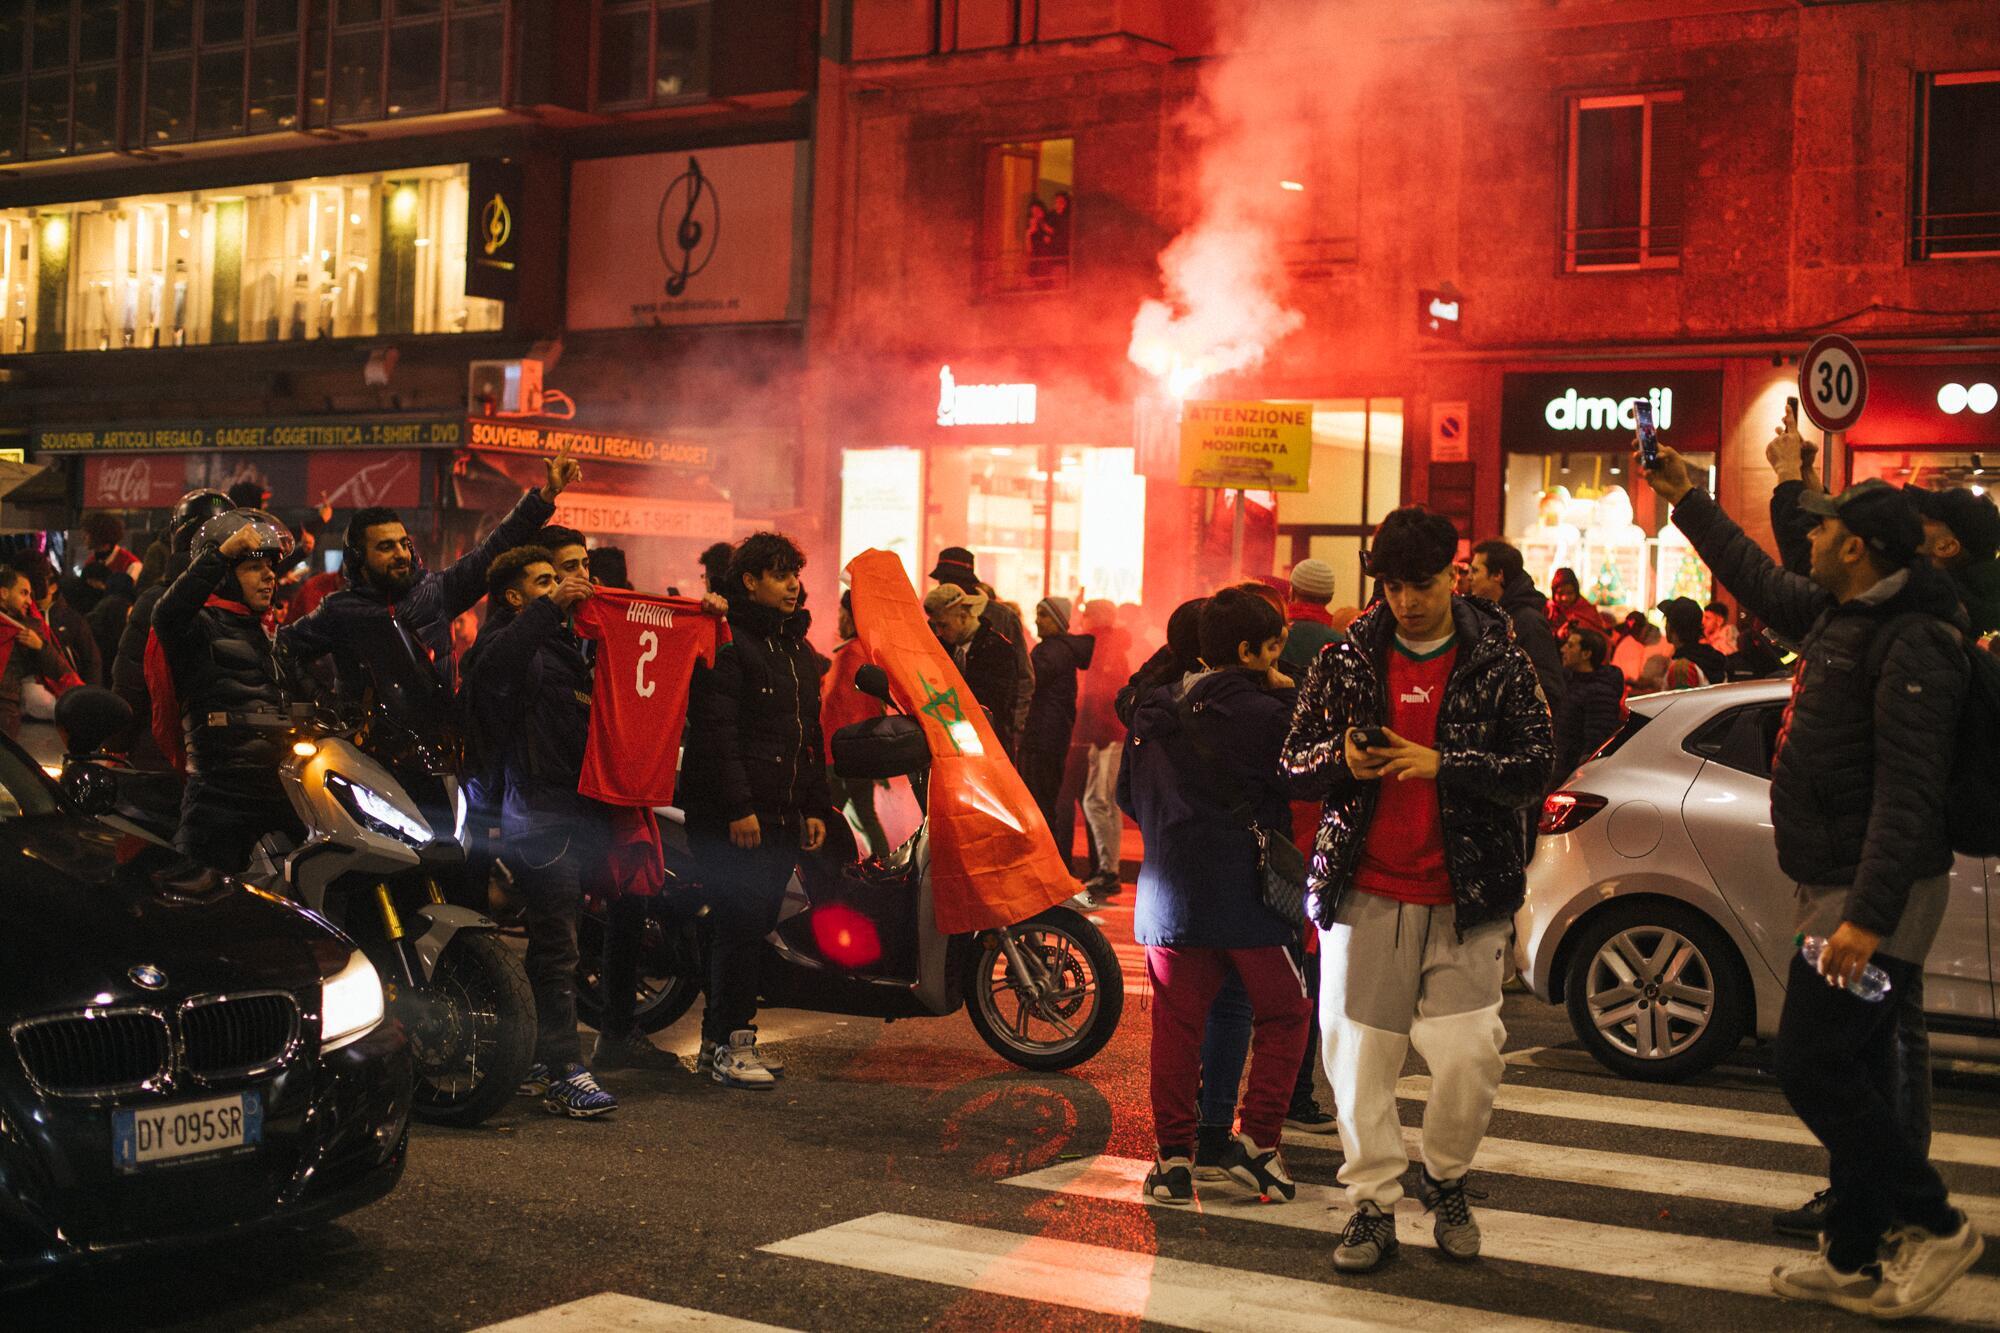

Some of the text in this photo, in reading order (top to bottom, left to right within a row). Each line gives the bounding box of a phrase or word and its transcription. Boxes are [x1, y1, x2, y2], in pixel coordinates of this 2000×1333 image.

[1817, 361, 1853, 406] 30
[1190, 407, 1305, 426] ATTENZIONE
[41, 424, 459, 449] SOUVENIR ARTICOLI REGALO GADGET OGGETTISTICA T-SHIRT DVD
[472, 424, 539, 448] SOUVENIR
[604, 437, 655, 460] REGALO
[1203, 440, 1288, 454] MODIFICATA
[553, 506, 632, 528] GETTISTICA
[626, 601, 675, 628] HAKIMI
[635, 630, 659, 698] 2
